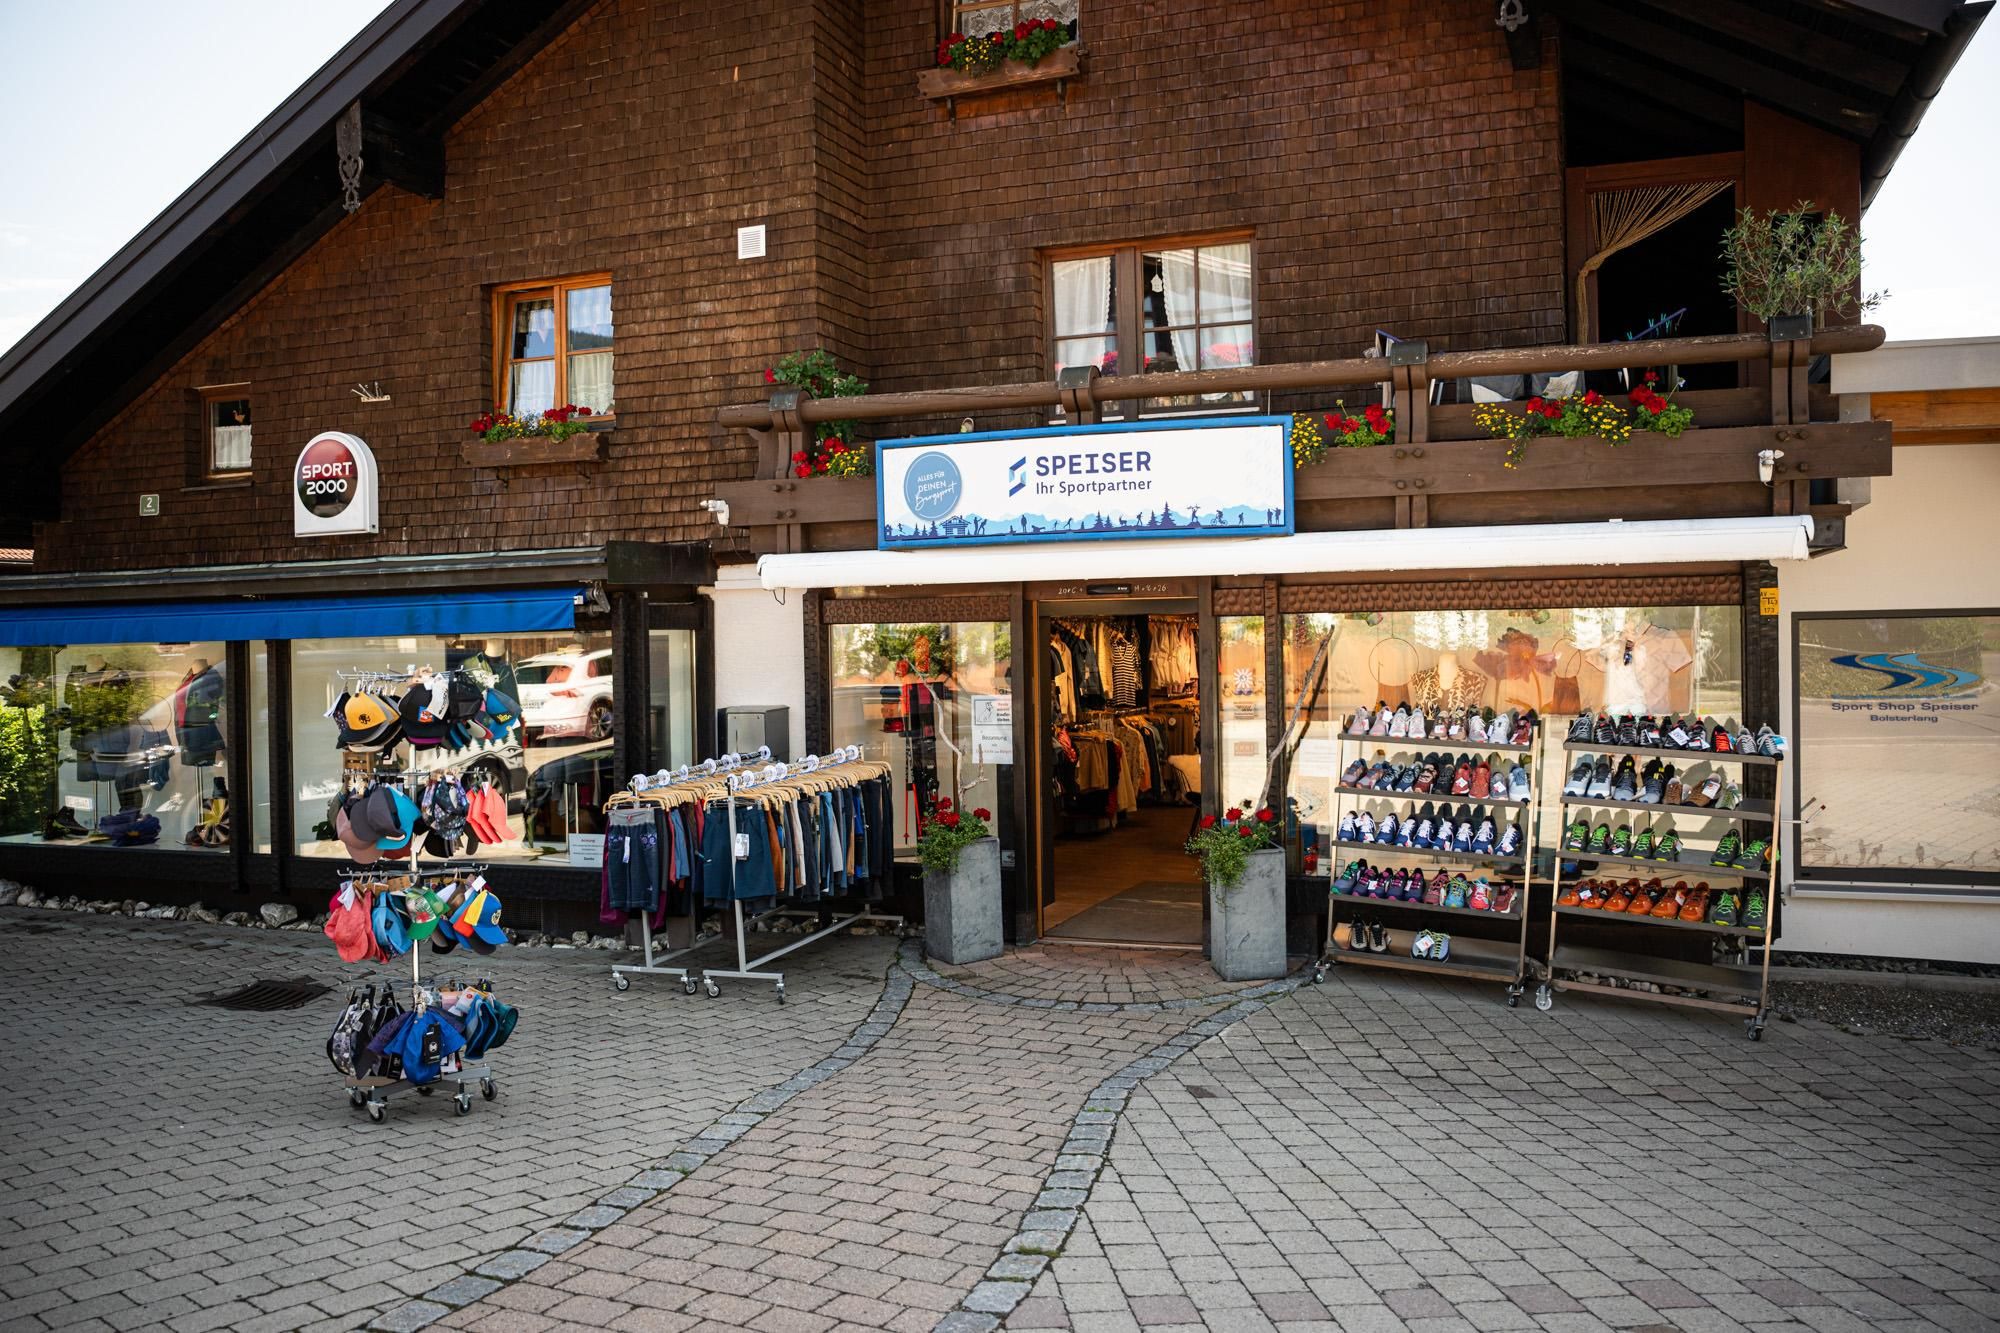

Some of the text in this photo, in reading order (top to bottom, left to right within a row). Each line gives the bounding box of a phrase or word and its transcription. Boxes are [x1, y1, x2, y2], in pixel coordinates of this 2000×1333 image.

[301, 461, 353, 479] SPORT
[1036, 451, 1152, 477] SPEISER
[917, 471, 945, 482] ALLES FÜR
[306, 479, 348, 496] 2000
[918, 480, 947, 493] DEINEN
[1036, 480, 1152, 496] Ihr Sportpartner
[146, 496, 153, 508] 2
[915, 481, 957, 511] Bergsport
[1831, 702, 1979, 712] Sport Shop Speiser
[1870, 714, 1939, 723] Bolsterlang
